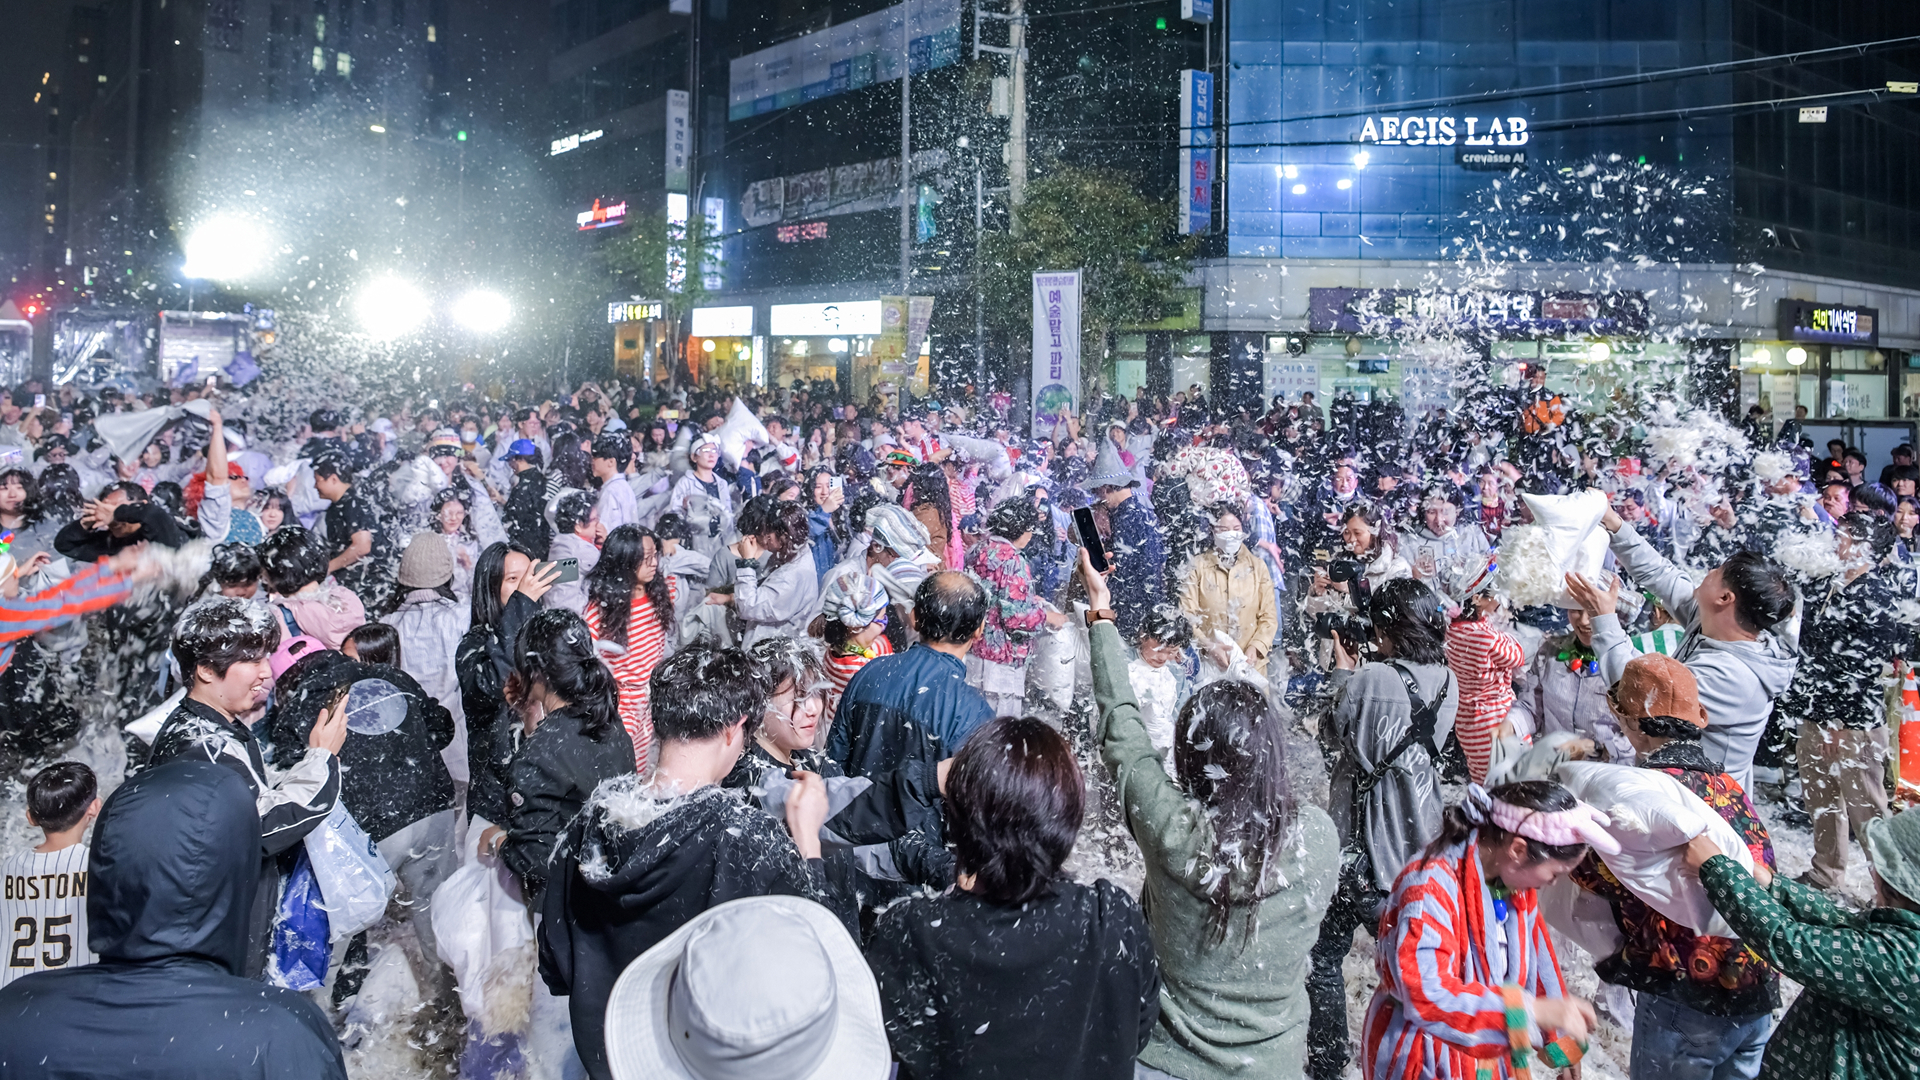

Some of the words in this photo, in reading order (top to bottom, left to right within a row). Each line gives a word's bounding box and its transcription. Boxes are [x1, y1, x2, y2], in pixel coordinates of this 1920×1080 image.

[1359, 117, 1456, 146] AEGIS
[1464, 117, 1529, 146] LAB
[1462, 153, 1511, 164] crevasse
[1813, 309, 1857, 333] 진미기사식당
[5, 871, 88, 900] BOSTON
[9, 914, 73, 968] 25
